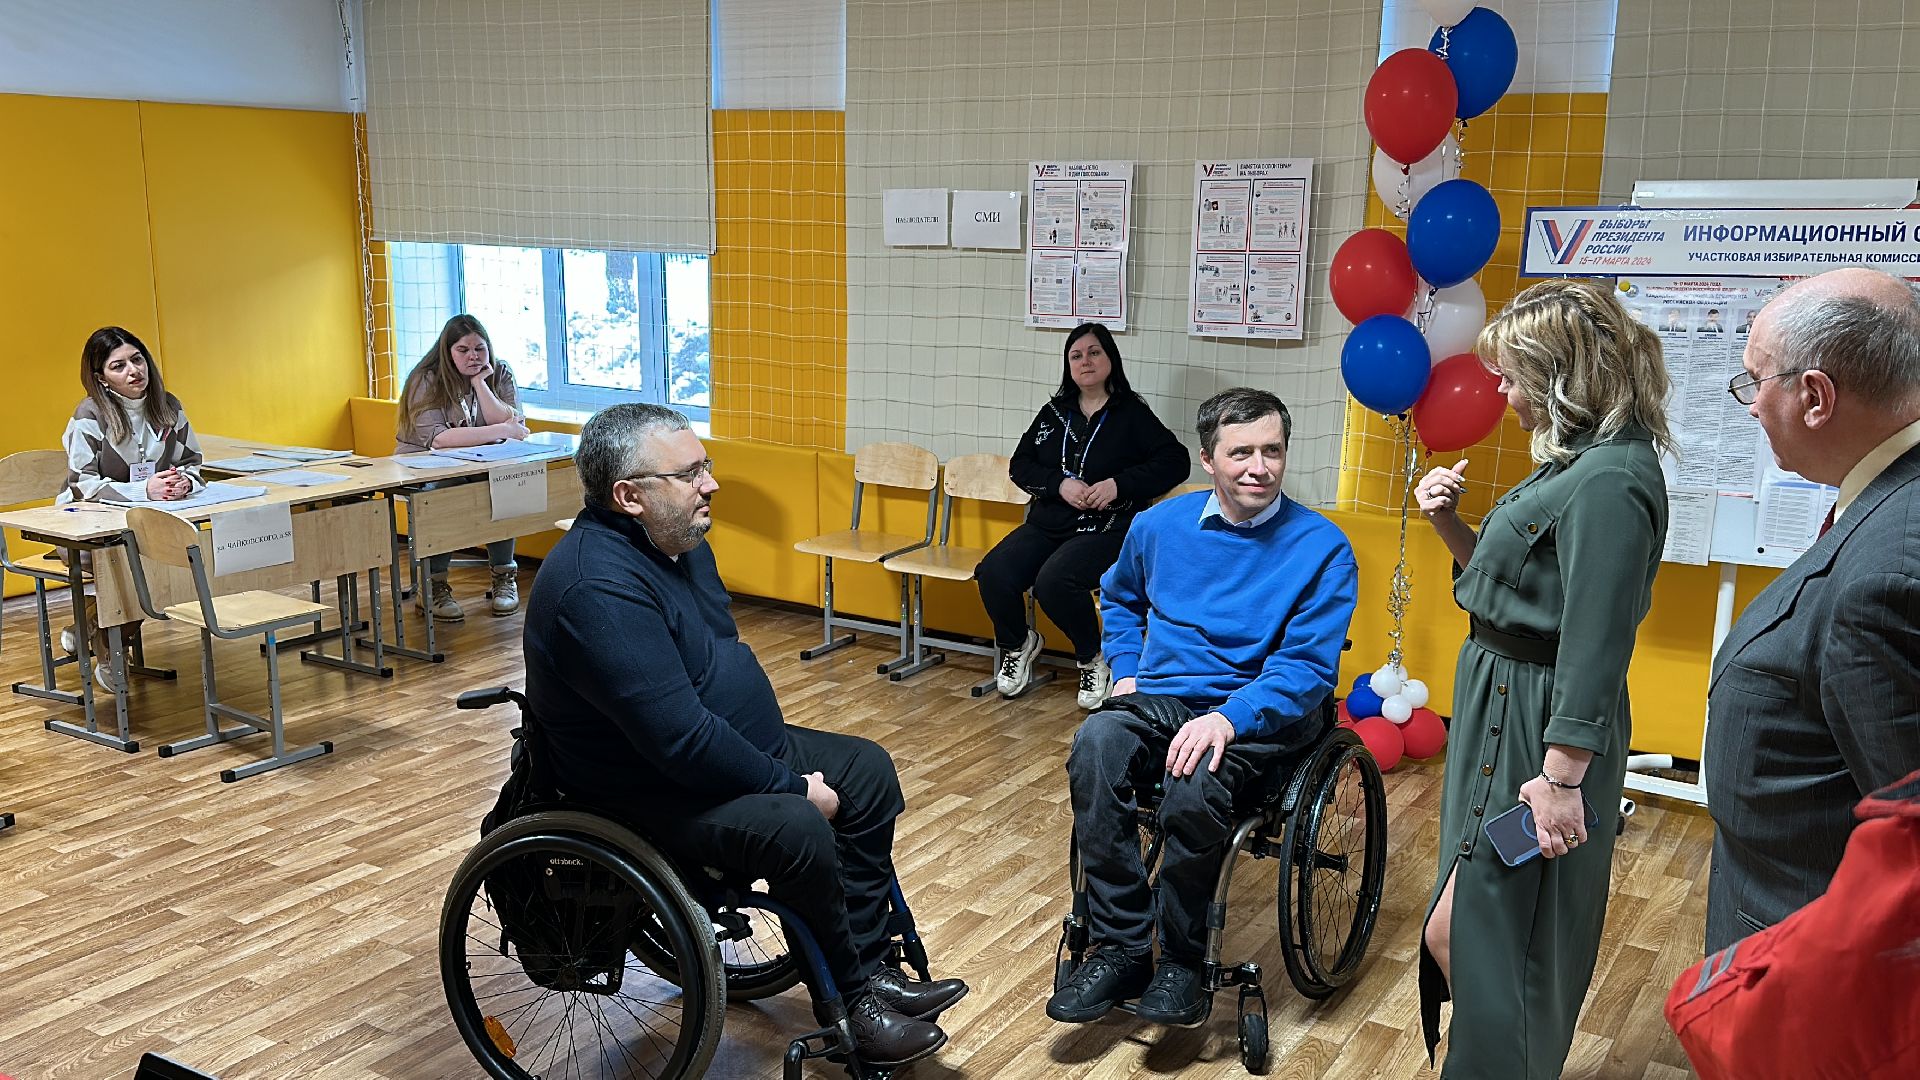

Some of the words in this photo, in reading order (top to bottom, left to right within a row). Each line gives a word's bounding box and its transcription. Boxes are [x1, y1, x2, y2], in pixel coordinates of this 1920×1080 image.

[974, 211, 1001, 223] СМИ
[1599, 219, 1651, 229] ВЫБОРЫ
[1591, 231, 1665, 243] ПРЕЗИДЕНТА
[1683, 221, 1907, 246] ИНФОРМАЦИОННЫЙ
[1584, 244, 1633, 254] РОССИИ
[1602, 257, 1630, 265] МАРТА
[1631, 257, 1653, 265] 2024
[1688, 252, 1761, 262] УЧАСТКОВАЯ
[1763, 252, 1863, 263] ИЗБИРАТЕЛЬНАЯ
